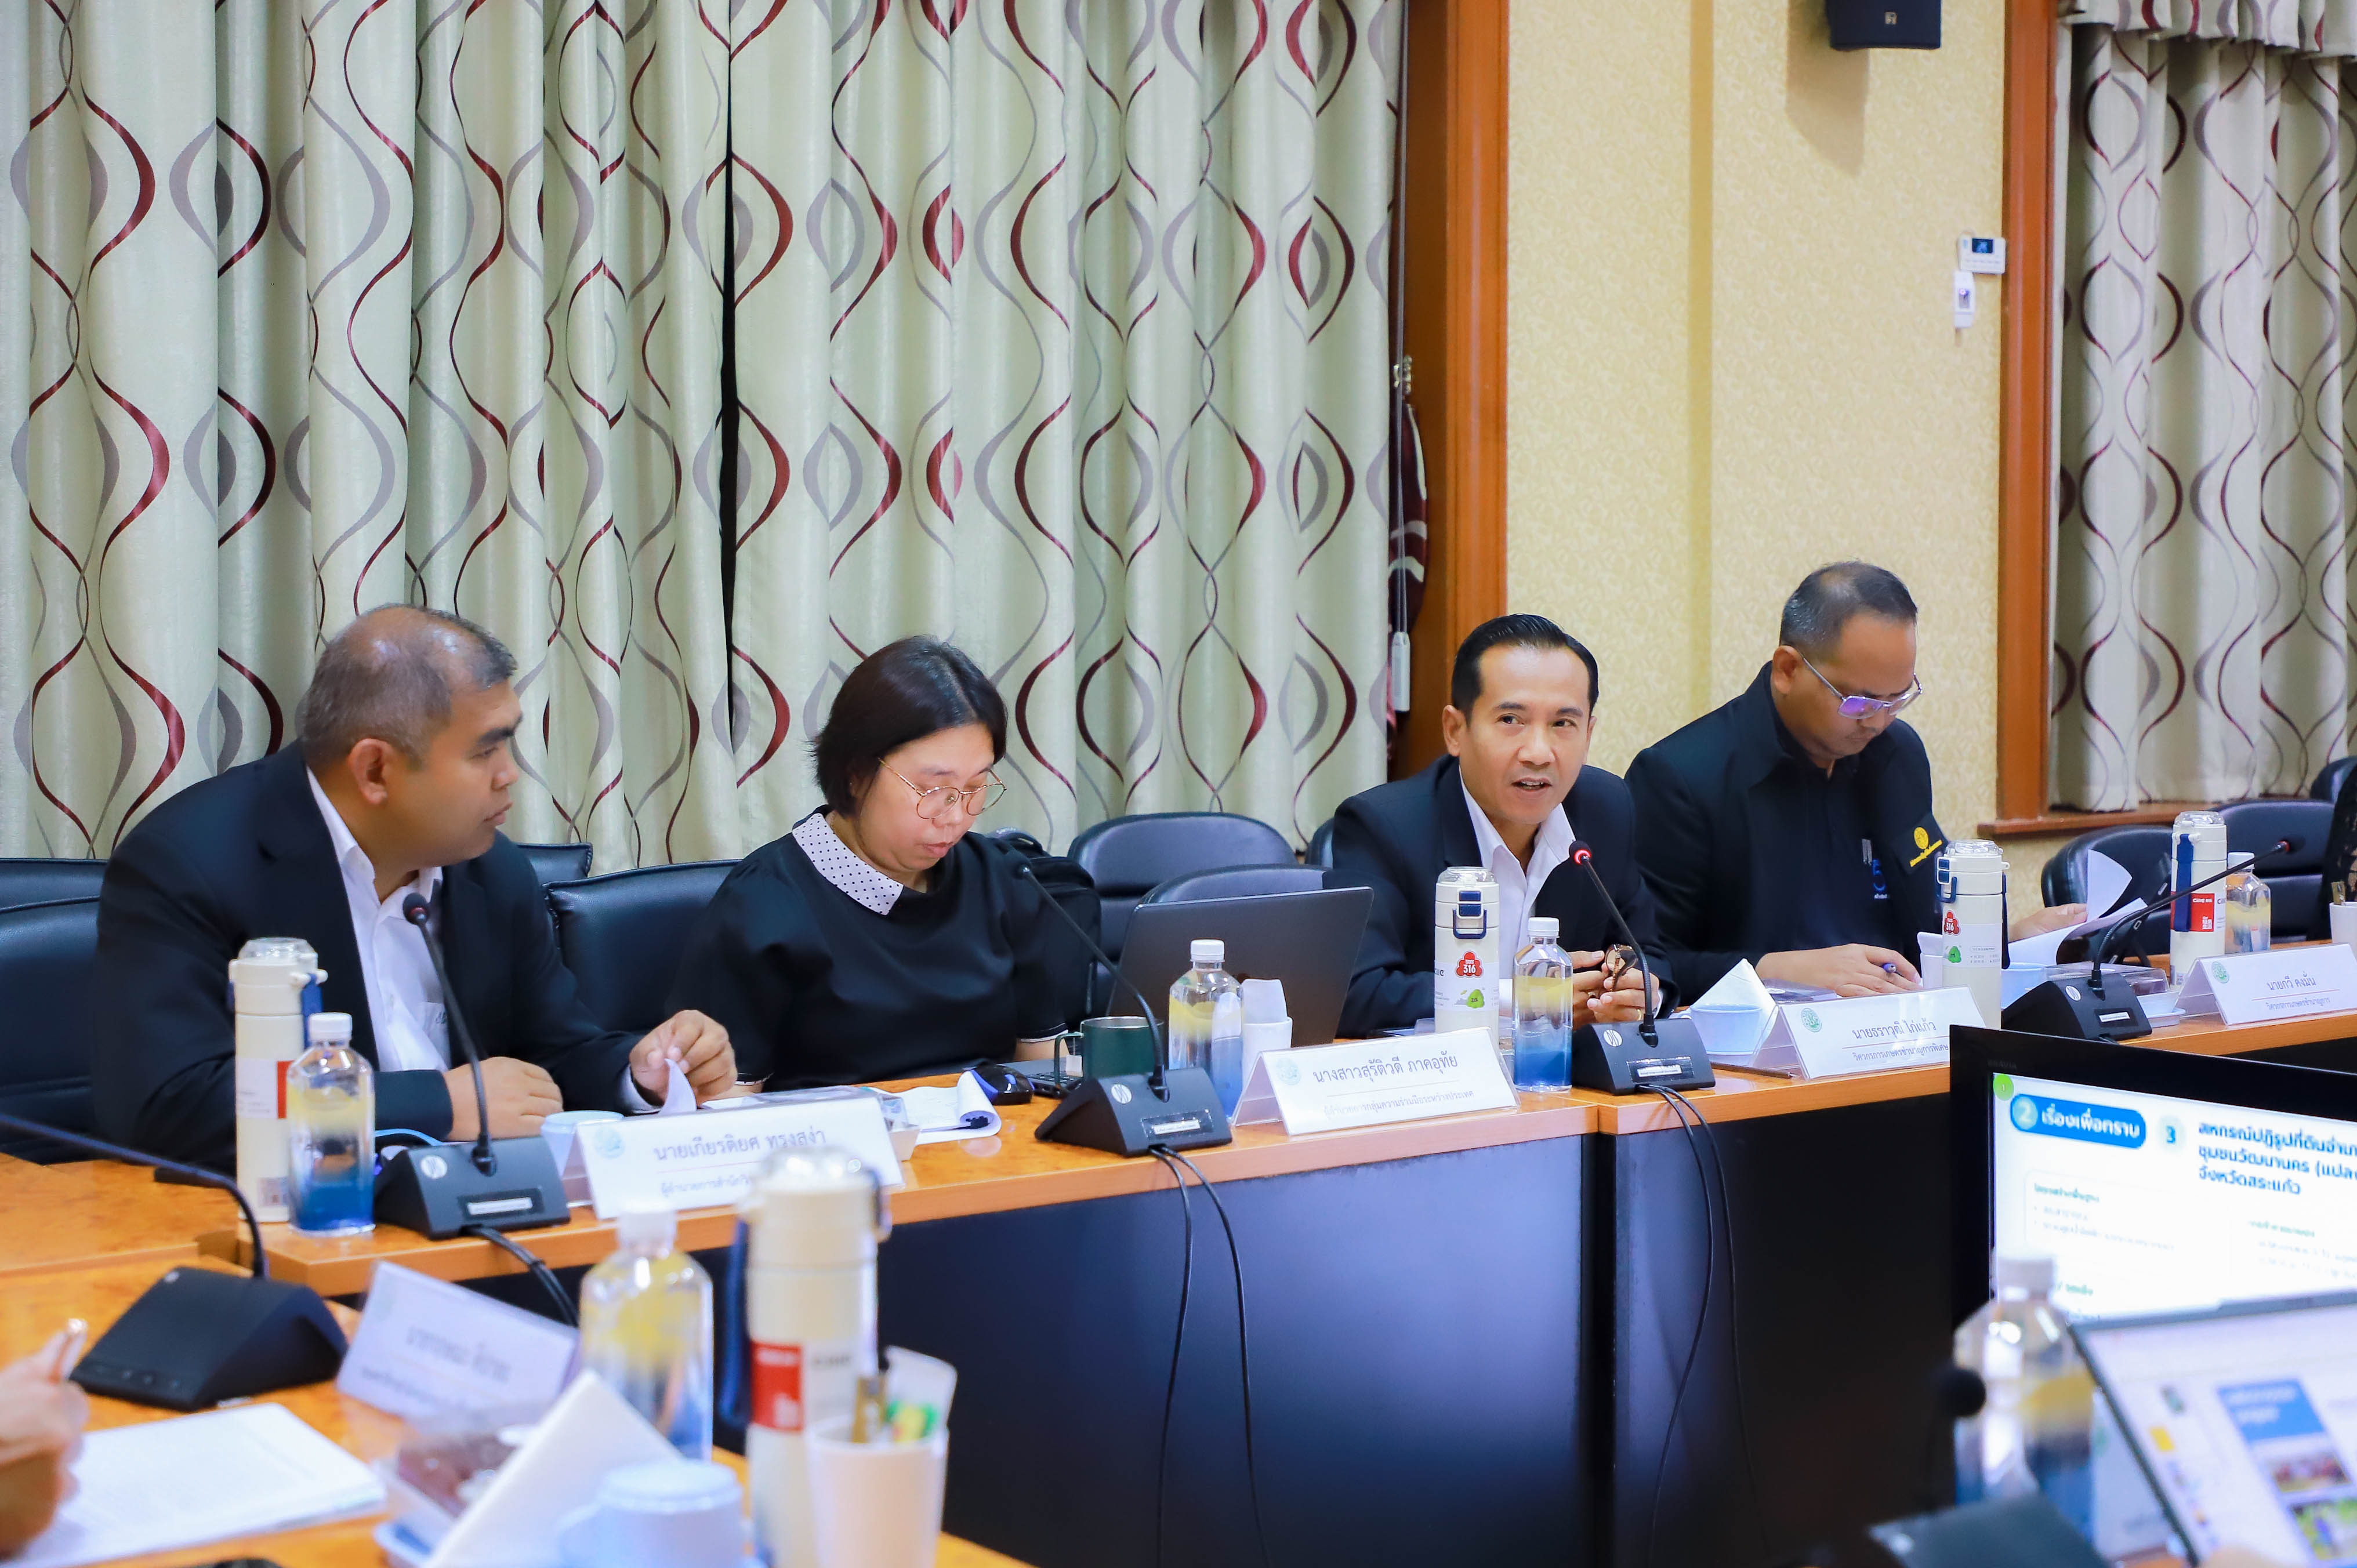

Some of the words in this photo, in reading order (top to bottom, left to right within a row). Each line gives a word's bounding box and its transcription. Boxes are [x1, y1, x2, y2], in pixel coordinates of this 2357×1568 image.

[1946, 923, 1955, 931] 316
[1463, 964, 1477, 974] 316
[2267, 975, 2294, 990] นายกวี
[1312, 1055, 1404, 1083] นางสาวสุรัติวดี
[1408, 1050, 1459, 1074] ภาคอุทัย
[2019, 1105, 2031, 1123] 2
[2166, 1127, 2176, 1144] 3
